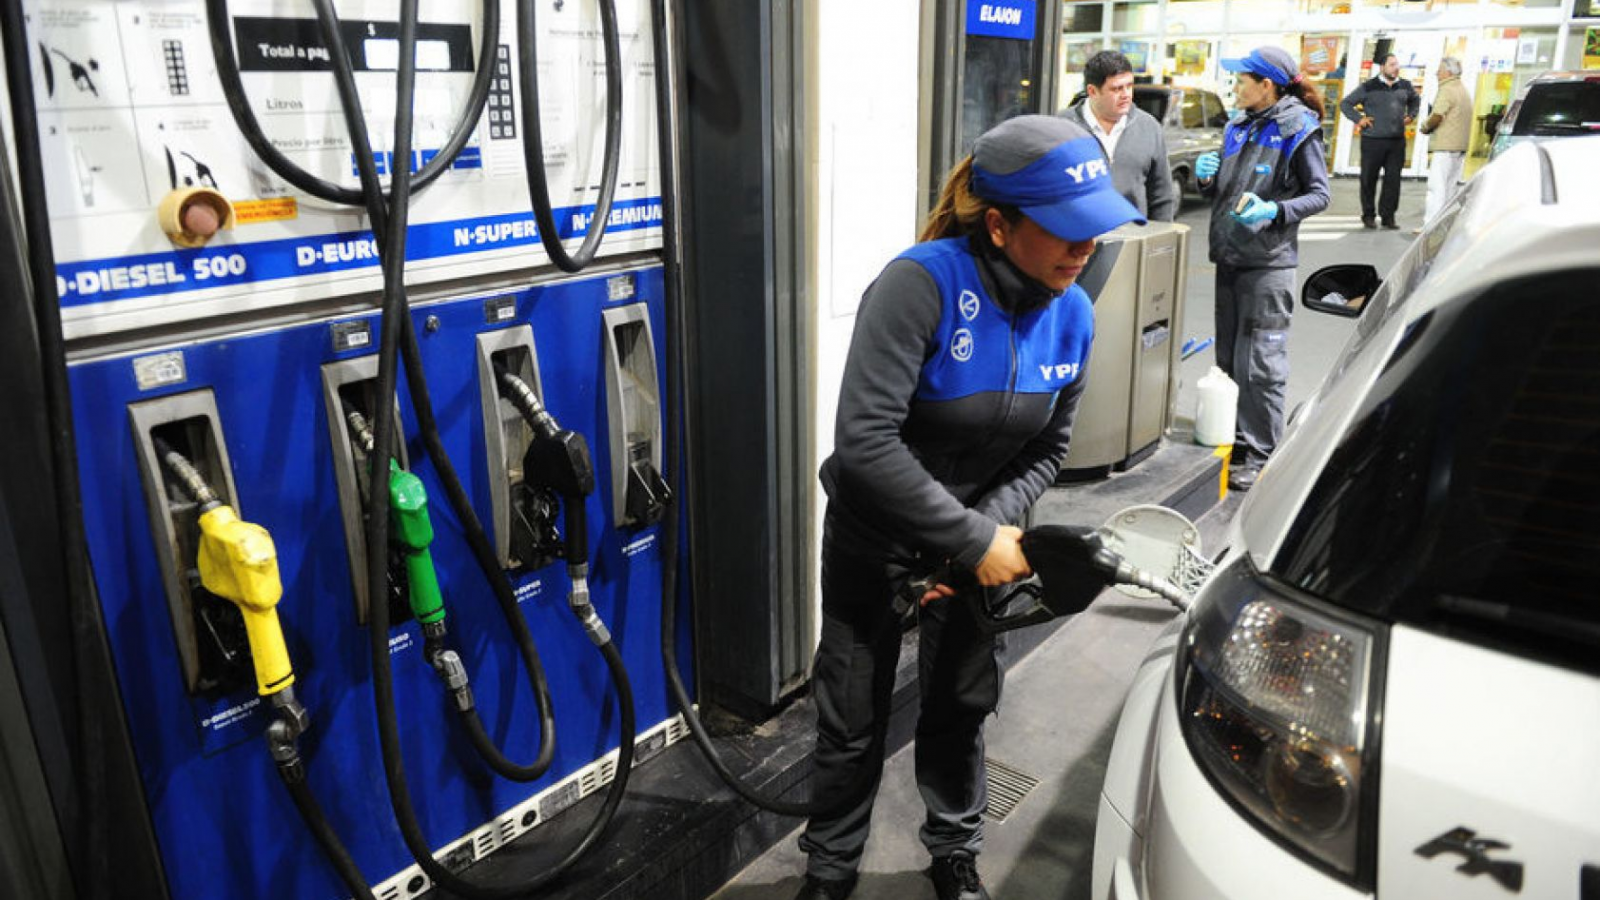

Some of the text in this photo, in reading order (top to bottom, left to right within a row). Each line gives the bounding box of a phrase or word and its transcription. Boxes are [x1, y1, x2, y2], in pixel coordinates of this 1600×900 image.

[258, 42, 295, 58] Total
[297, 48, 306, 58] a
[266, 98, 304, 110] Litros
[193, 254, 247, 280] 500
